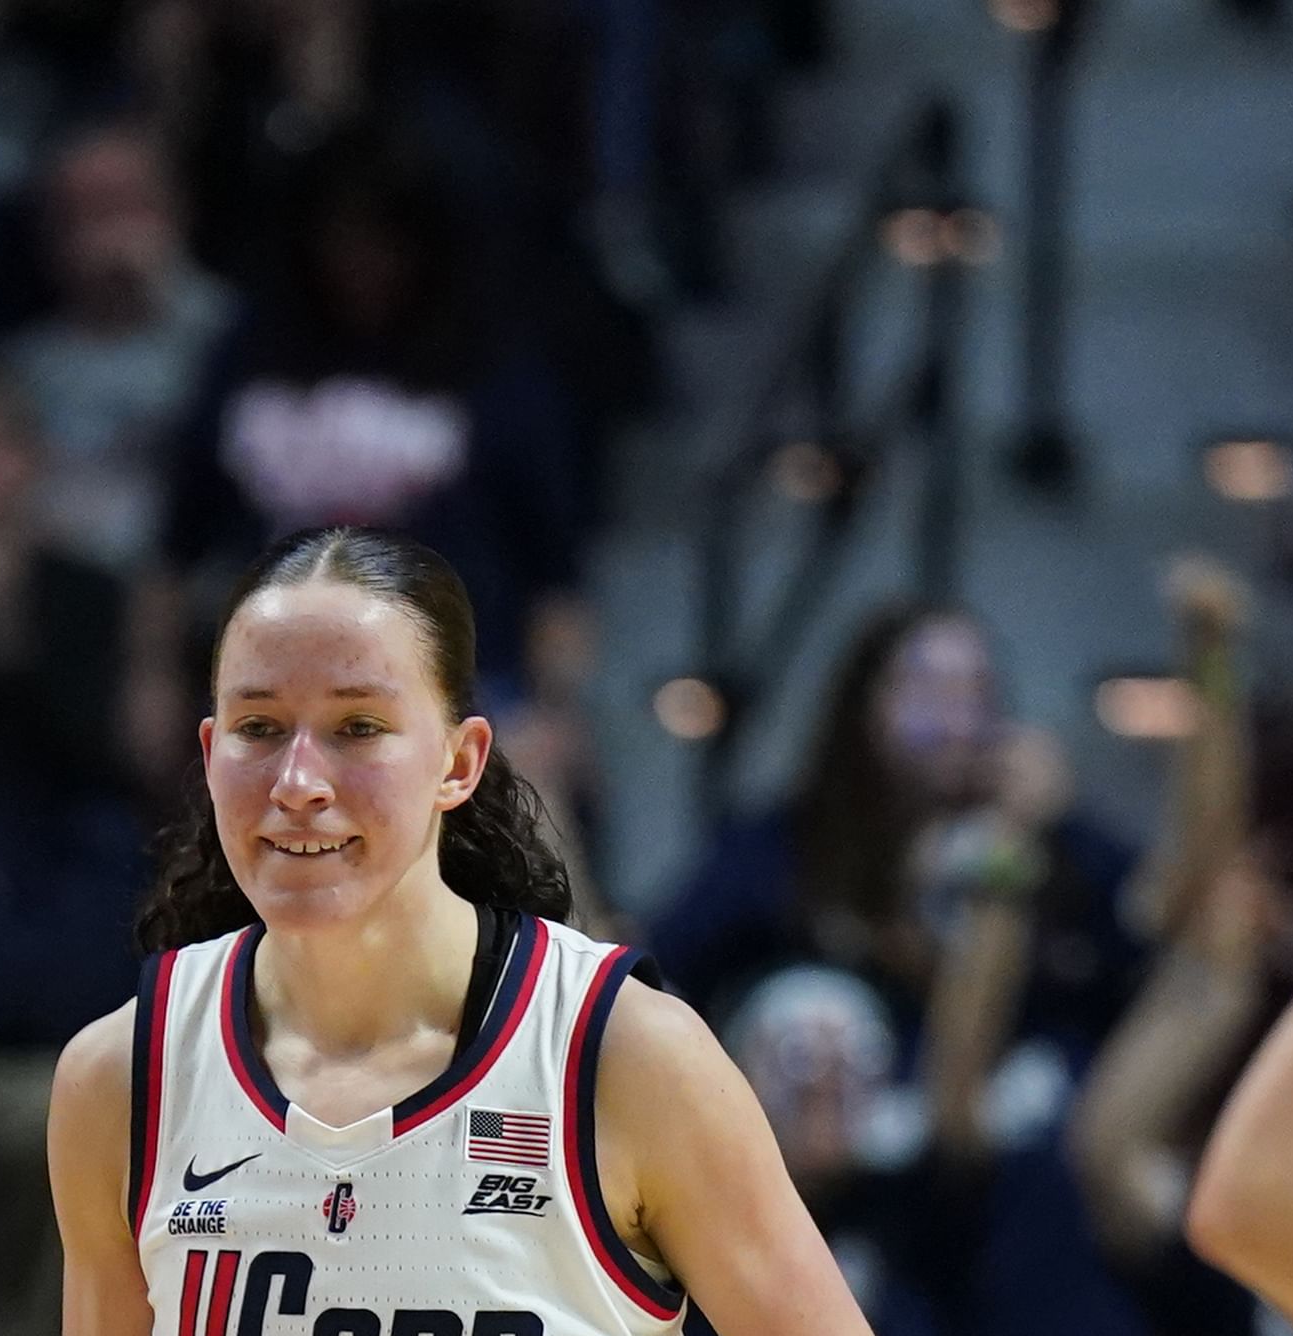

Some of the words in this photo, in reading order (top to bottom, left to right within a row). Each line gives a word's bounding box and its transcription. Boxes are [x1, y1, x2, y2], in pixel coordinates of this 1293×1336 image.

[477, 1174, 537, 1193] BIG
[173, 1201, 195, 1216] BE
[197, 1200, 226, 1216] THE
[468, 1191, 553, 1210] EAST
[168, 1217, 226, 1235] CHANGE
